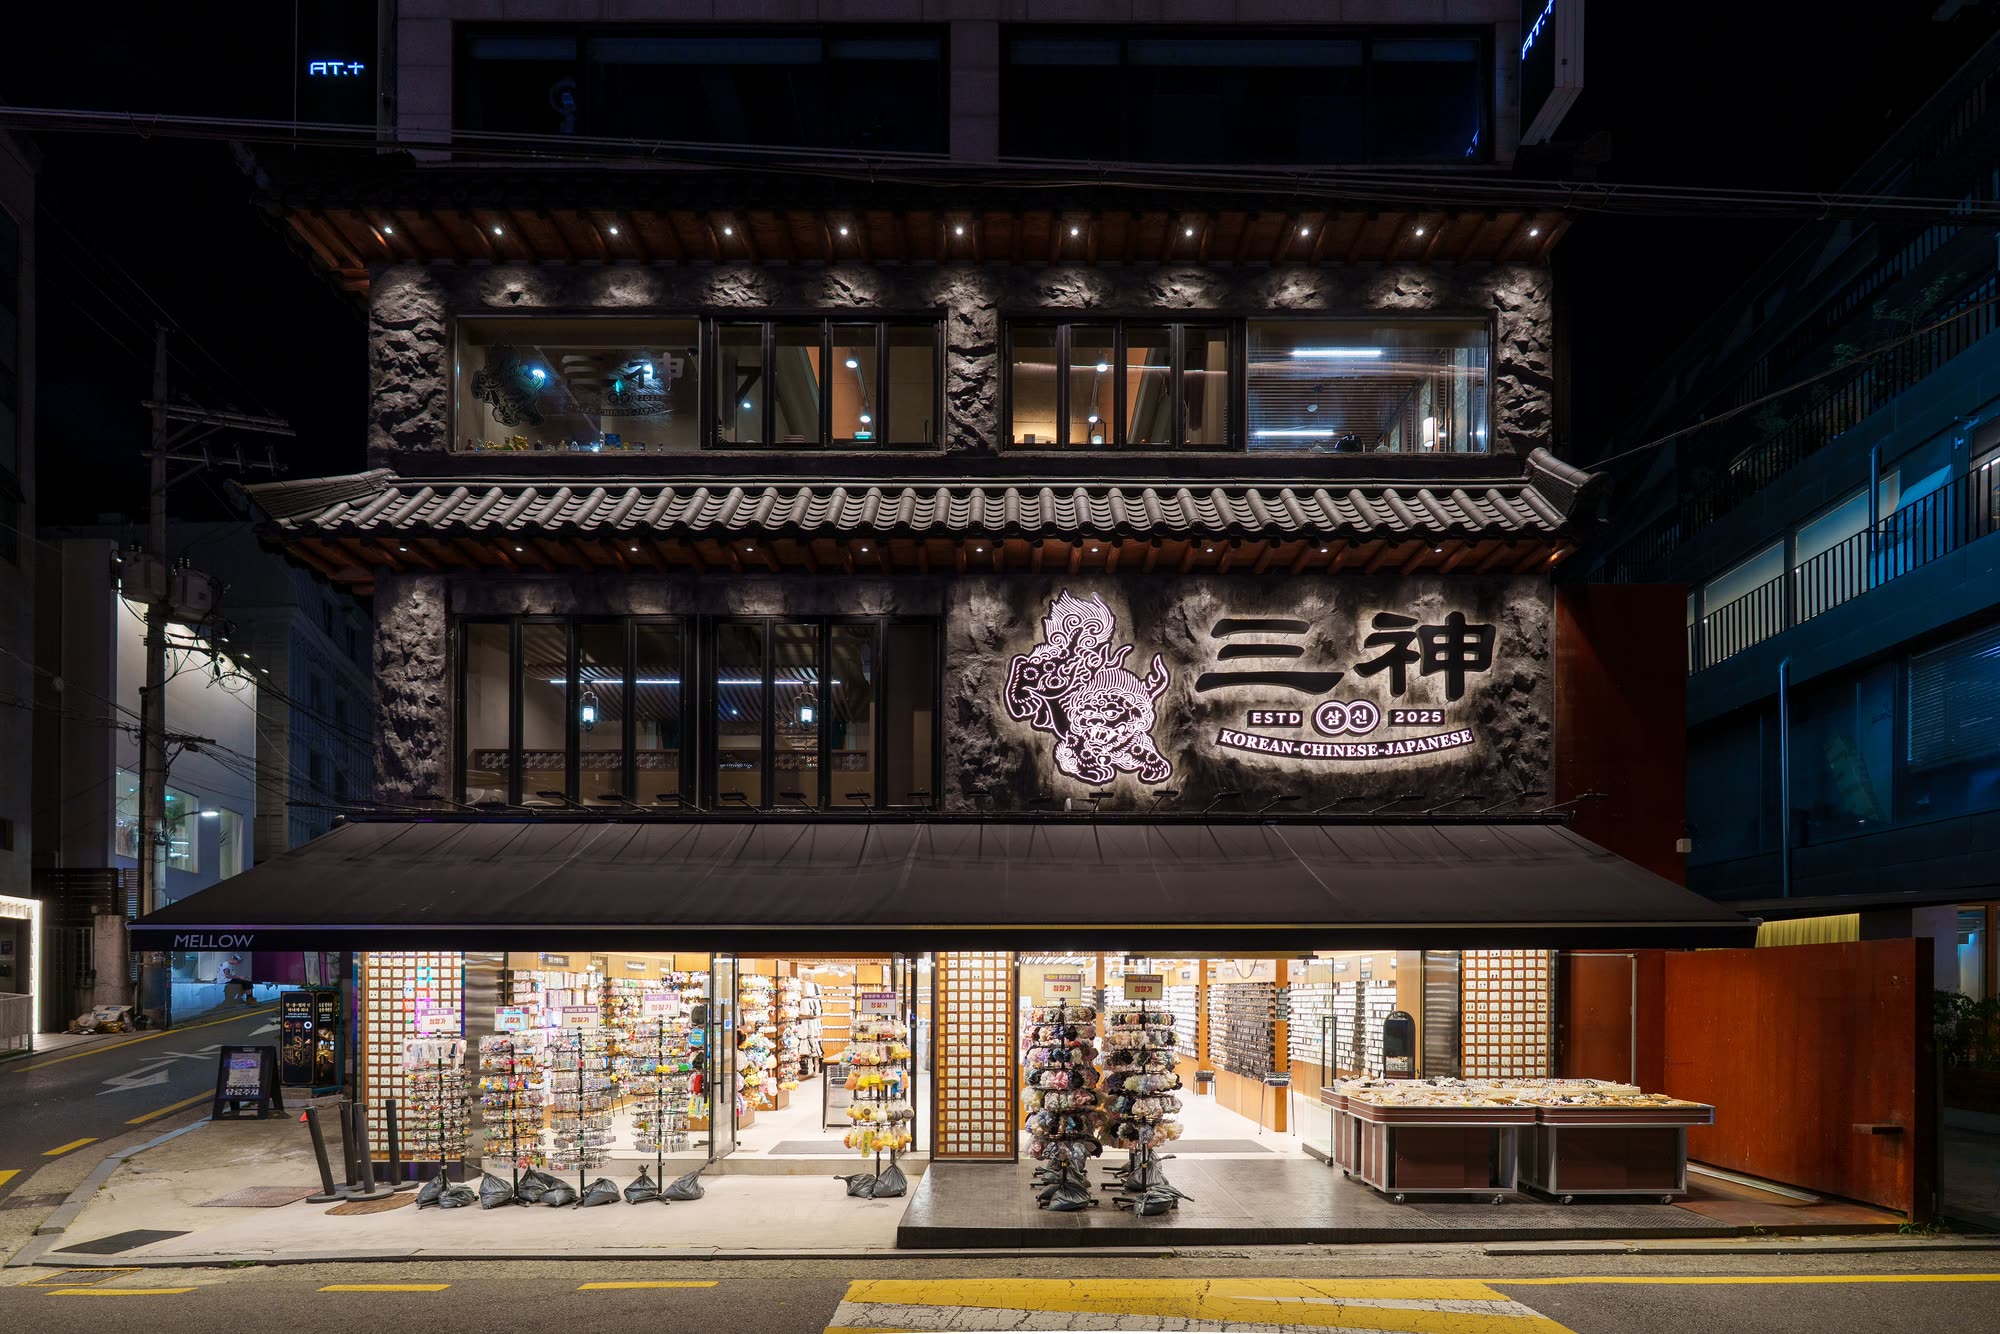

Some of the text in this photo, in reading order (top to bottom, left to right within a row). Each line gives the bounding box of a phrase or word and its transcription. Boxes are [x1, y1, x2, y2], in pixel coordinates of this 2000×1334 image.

[1194, 611, 1497, 702] 三神
[1252, 711, 1302, 725] ESTD
[1394, 711, 1443, 724] 2025
[1220, 729, 1473, 758] KOREAN-CHINESE-JAPANESE
[173, 933, 255, 949] MELLOW
